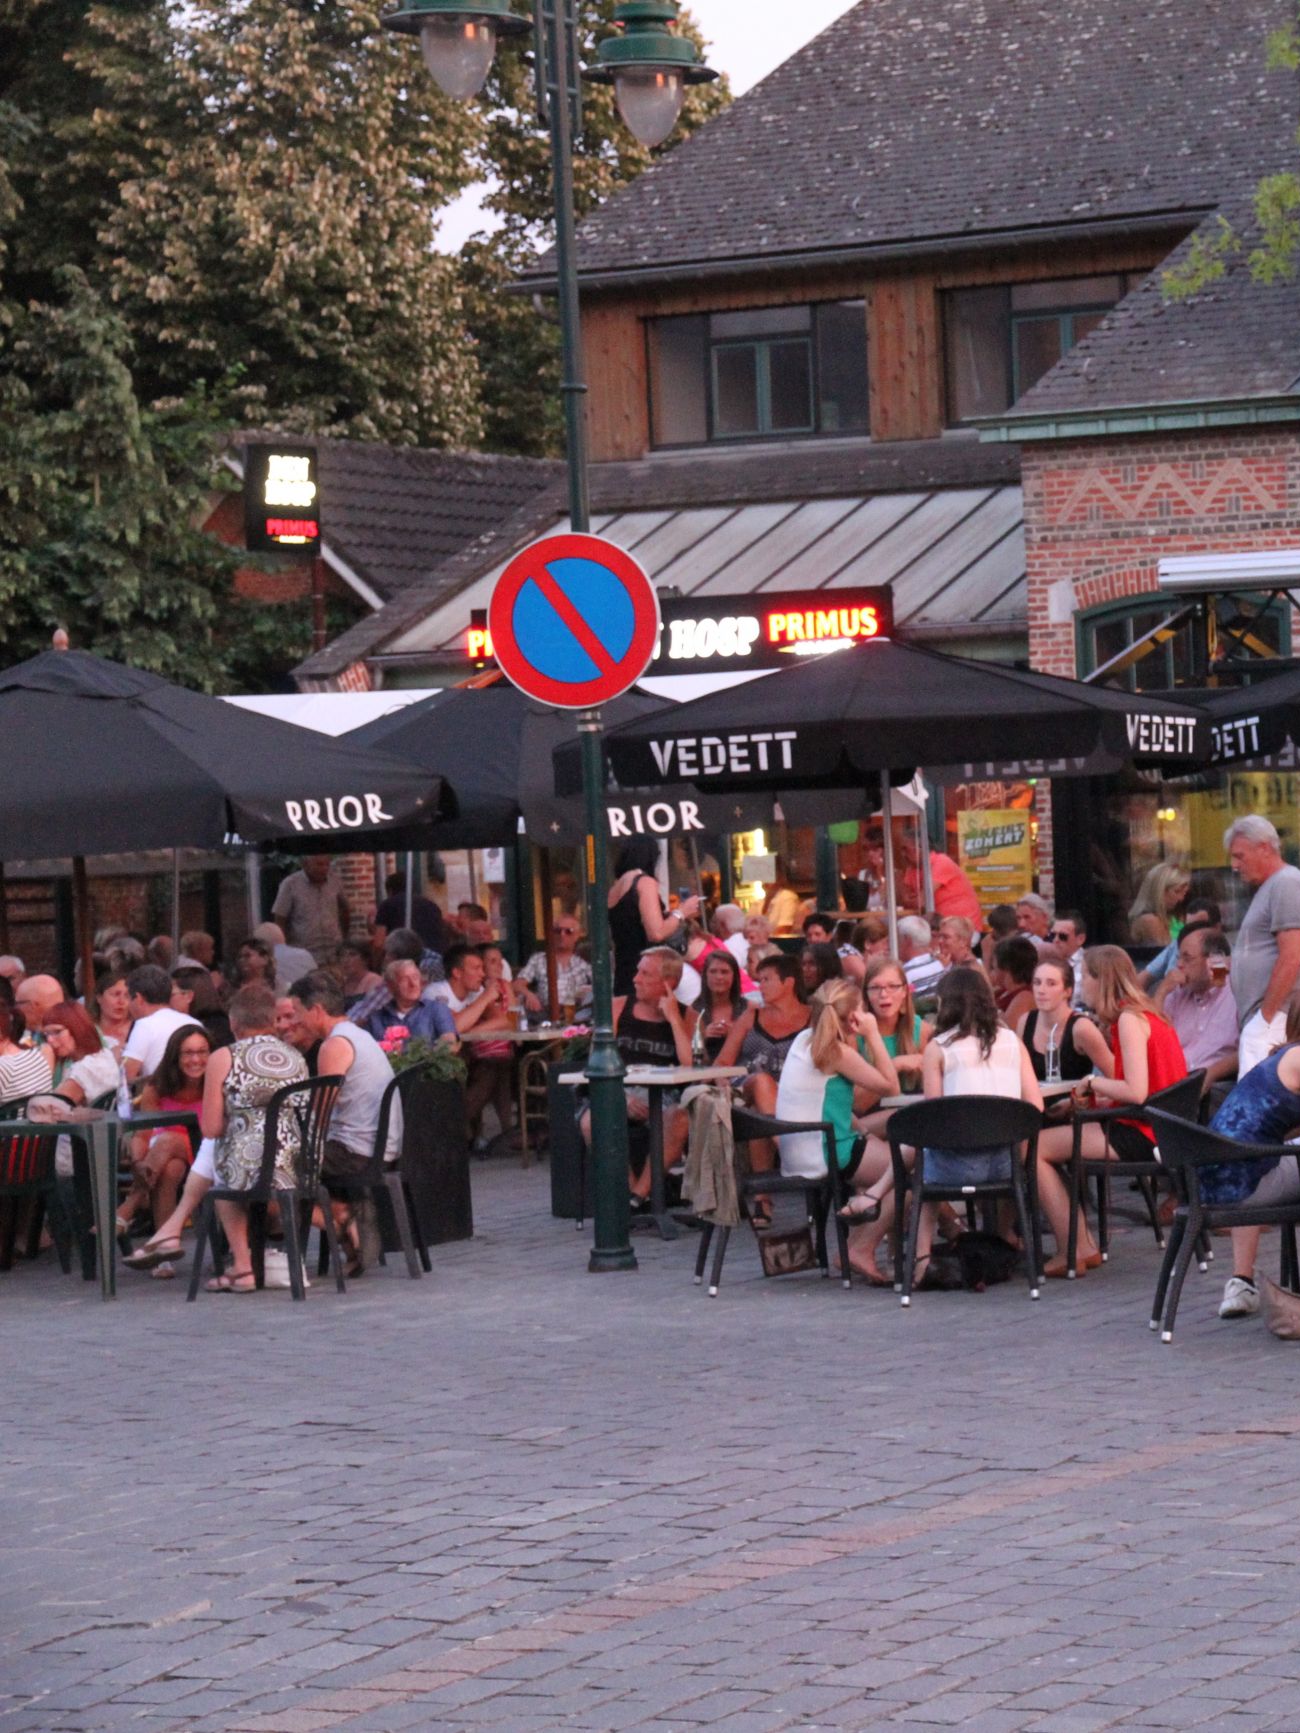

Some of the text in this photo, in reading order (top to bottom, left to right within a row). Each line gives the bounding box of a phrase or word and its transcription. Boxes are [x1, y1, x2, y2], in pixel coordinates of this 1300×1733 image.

[266, 518, 318, 537] PRIMUS
[668, 616, 760, 660] HOSP
[768, 607, 878, 642] PRIMUS
[1126, 714, 1197, 753] VEDETT
[650, 731, 798, 777] VEDETT
[285, 793, 394, 831] PRIOR
[607, 801, 705, 837] RIOR
